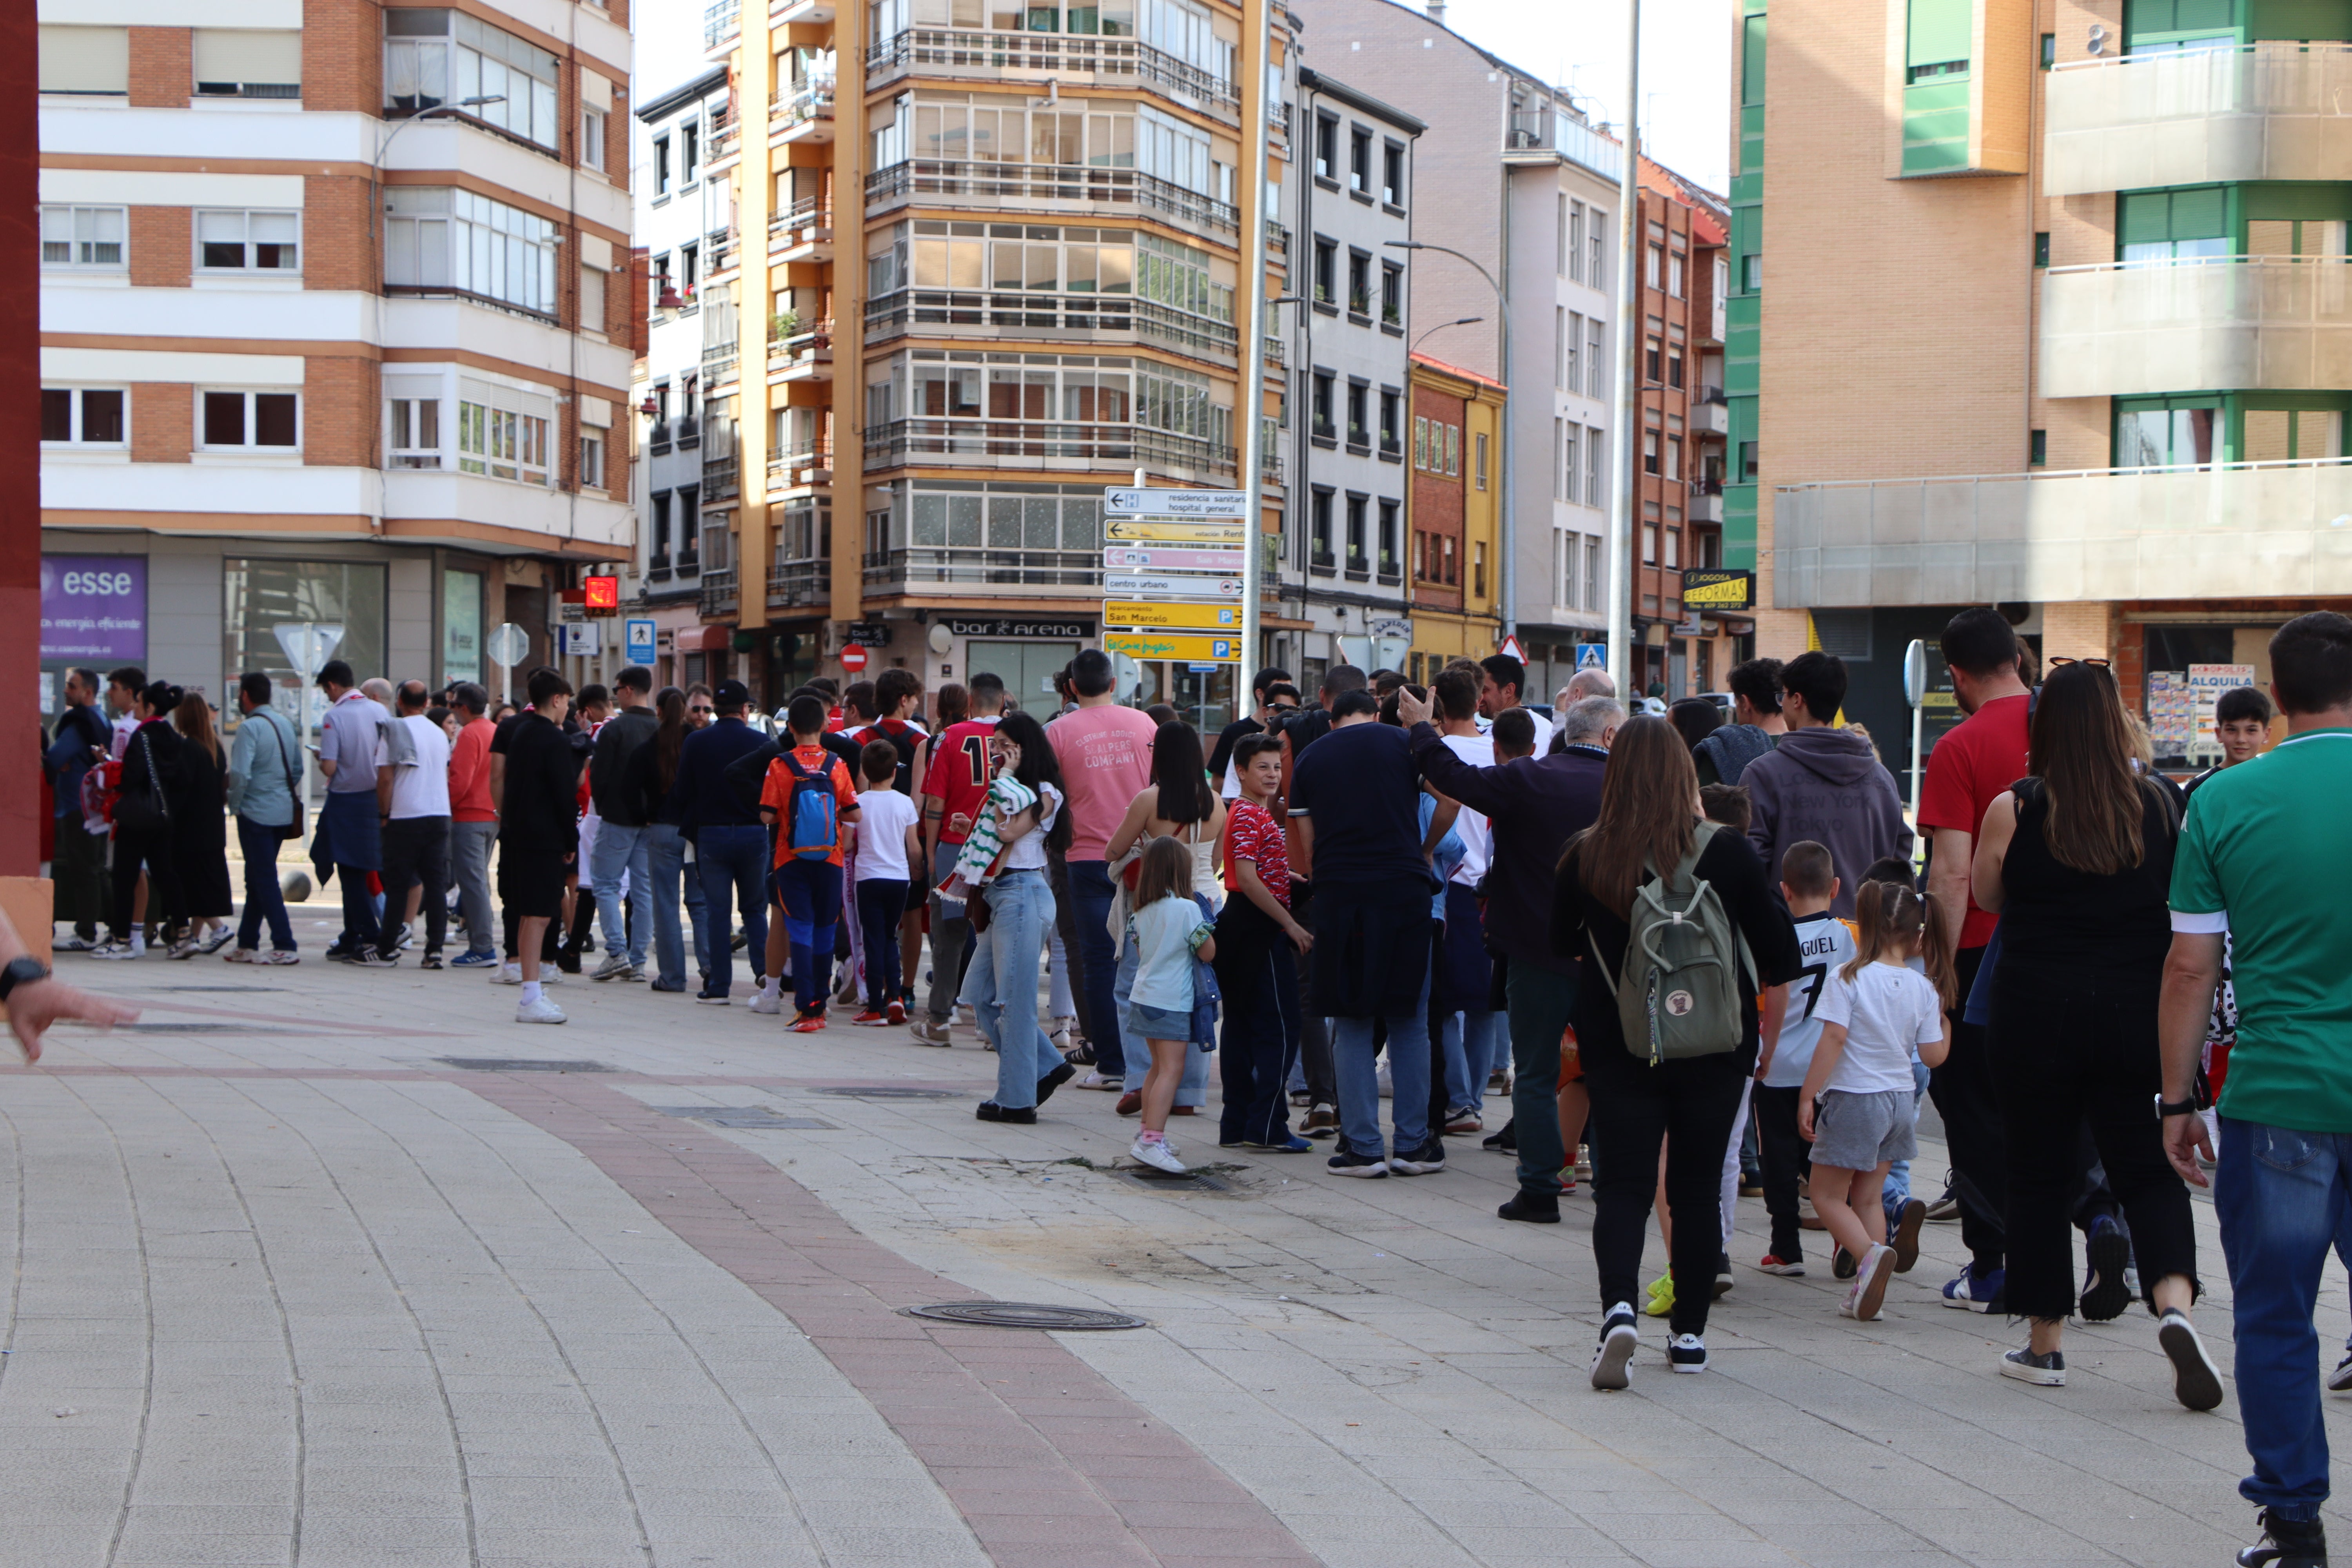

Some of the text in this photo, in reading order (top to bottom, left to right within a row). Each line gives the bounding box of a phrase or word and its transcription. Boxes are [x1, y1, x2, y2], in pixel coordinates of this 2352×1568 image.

[1169, 494, 1209, 502] residencia
[1169, 503, 1201, 512] hospital
[1196, 555, 1243, 564] San Marco
[63, 571, 132, 595] esse
[1685, 579, 1745, 600] REFORMAS
[1131, 614, 1167, 622] Marcelo
[1221, 611, 1230, 622] P
[953, 620, 992, 634] bar
[1376, 621, 1411, 633] RAPIDIN
[1216, 642, 1227, 655] P
[2191, 677, 2252, 686] ALQUILA
[1076, 731, 1107, 746] CLOTHING
[1085, 740, 1132, 755] SCALPERS
[1085, 751, 1135, 768] COMPANY
[1783, 791, 1870, 809] New York
[1787, 815, 1844, 837] Tokyo
[1800, 936, 1838, 956] GUEL
[1797, 962, 1827, 1022] 7
